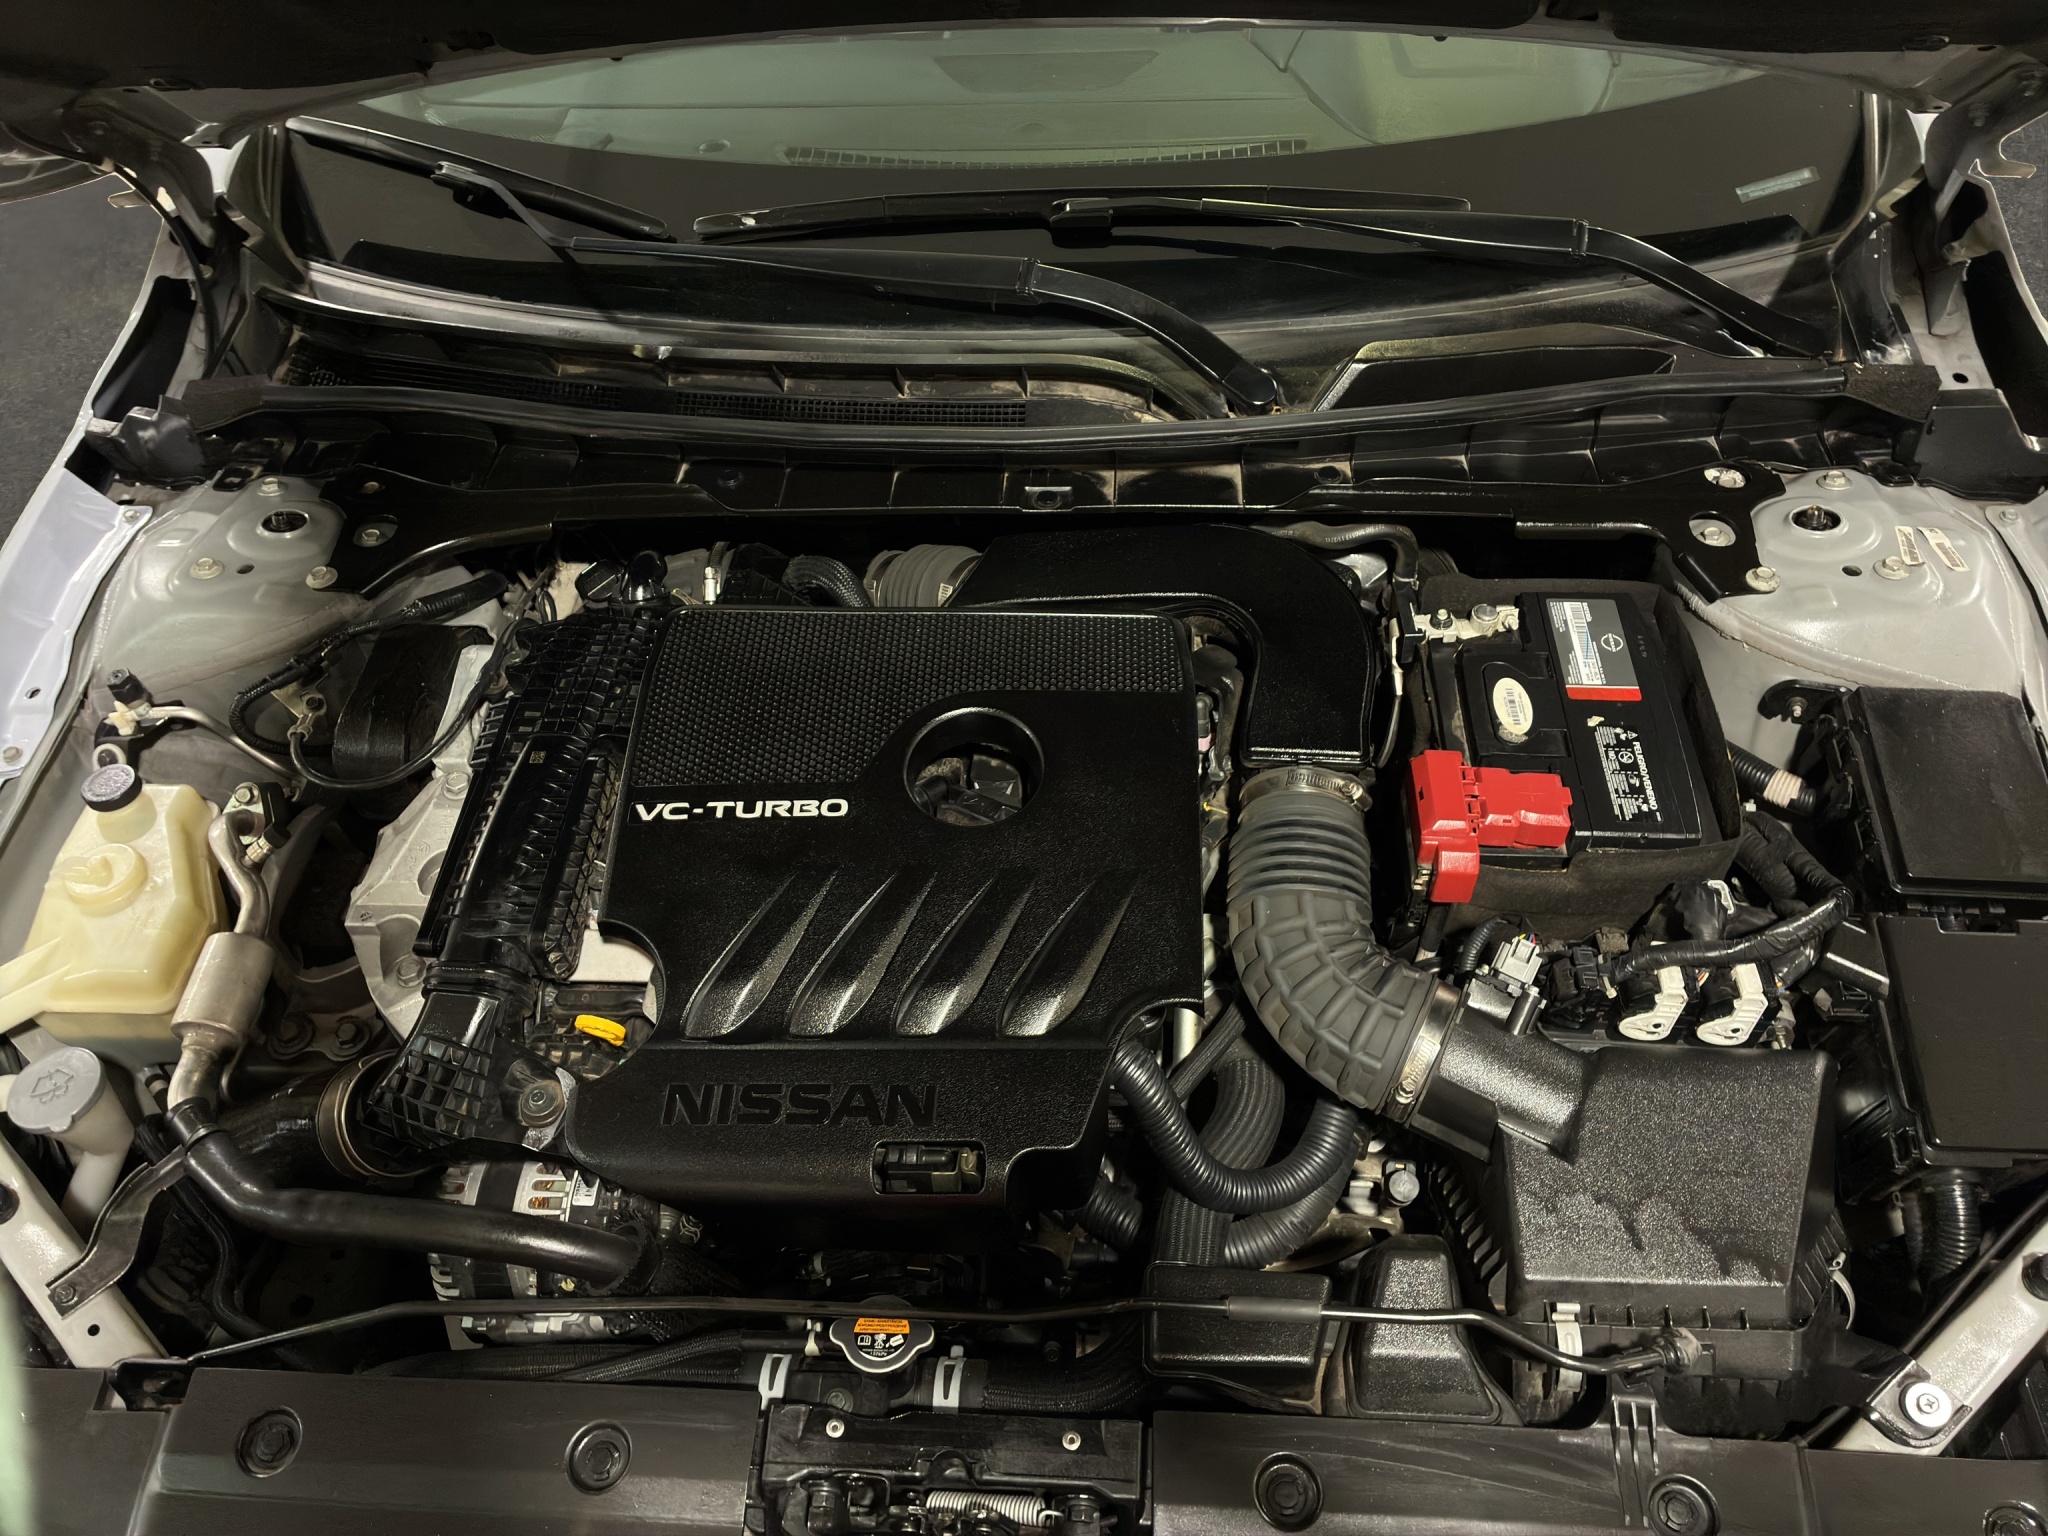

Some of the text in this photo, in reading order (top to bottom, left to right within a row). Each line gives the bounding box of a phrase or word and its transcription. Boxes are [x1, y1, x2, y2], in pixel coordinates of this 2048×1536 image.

[1608, 633, 1616, 653] NISSAN
[1632, 741, 1658, 810] PELIGRO/VENENO
[635, 798, 849, 821] VC-TURBO
[660, 1083, 937, 1126] NISSAN
